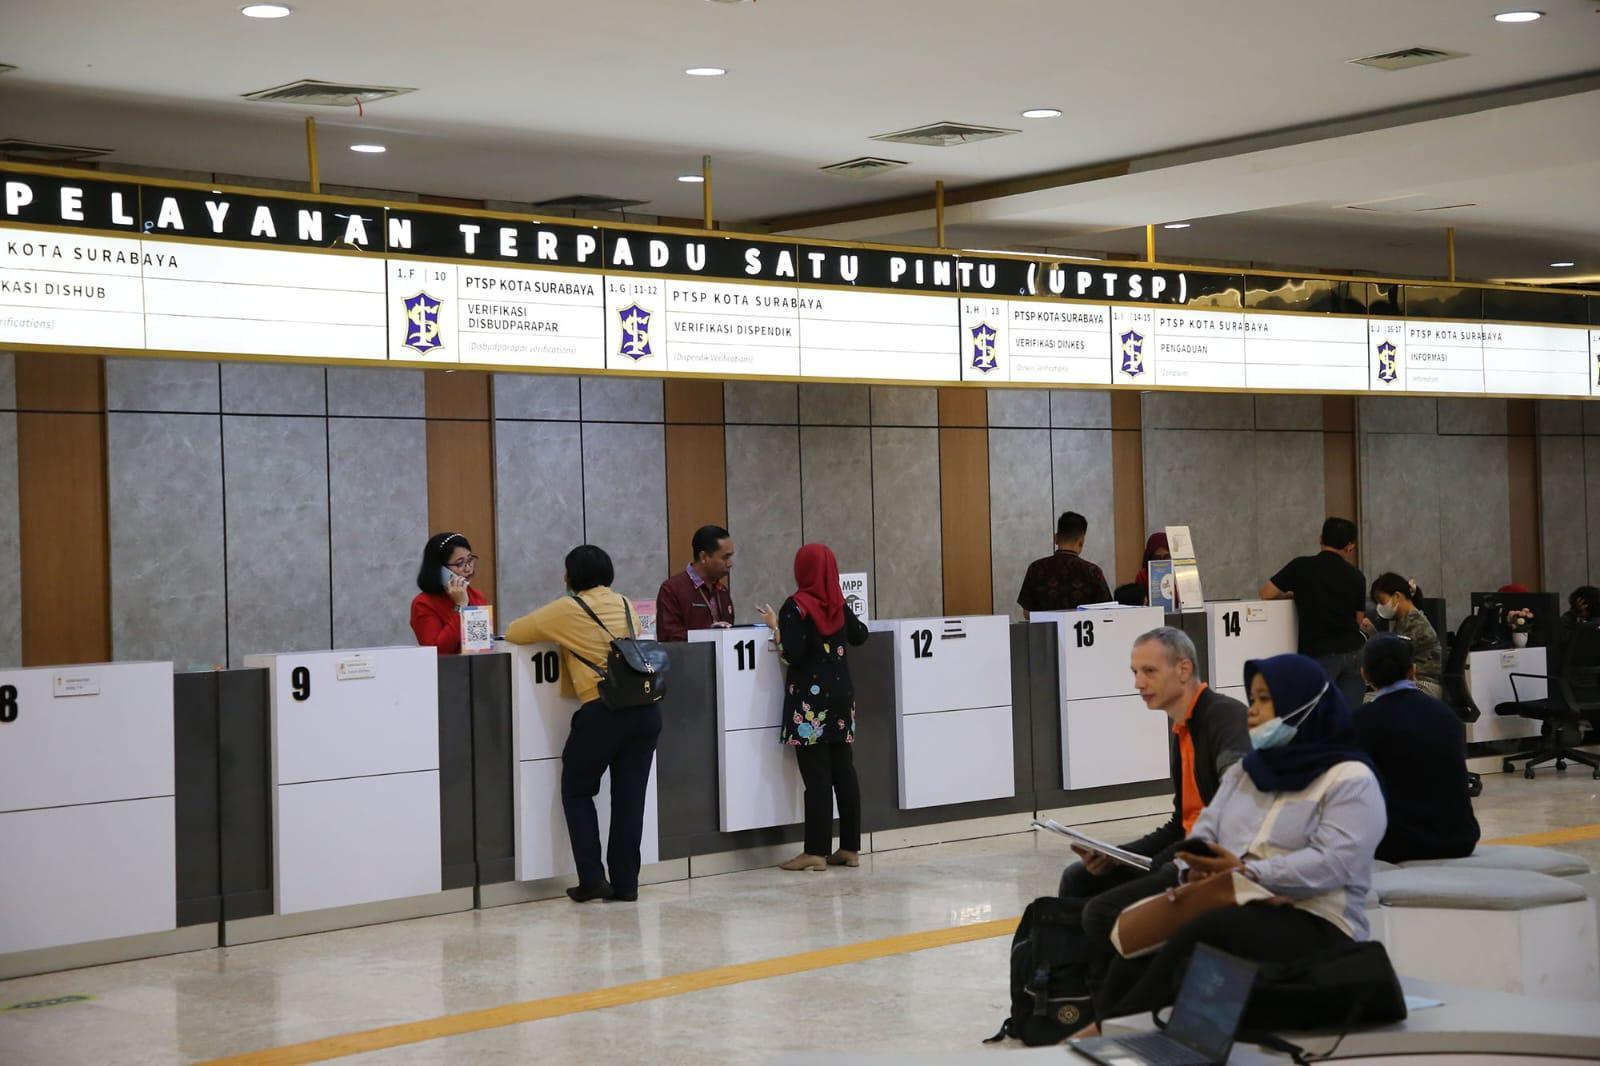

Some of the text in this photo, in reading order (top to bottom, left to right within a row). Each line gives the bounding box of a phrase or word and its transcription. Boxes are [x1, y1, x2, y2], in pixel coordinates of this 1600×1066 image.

[5, 181, 1187, 303] PELAYANAN TERPADU SATU PINTU (UPTSP)
[7, 241, 178, 269] KOTA SURABAYA
[435, 271, 446, 281] 10
[1, 280, 106, 299] KASI DISHUB
[465, 276, 595, 297] PTSP KOTA SURABAYA
[634, 285, 657, 295] 11-12
[672, 290, 823, 310] PTSP KOTA SURABAYA
[467, 303, 527, 317] VERIFIKASI
[1014, 310, 1104, 324] PTSP KOTA SURABAYA
[468, 317, 559, 333] DISBUDPARAPAR
[674, 321, 792, 337] VERIFIKASI DISPENDIK
[1160, 317, 1269, 333] PTSP KOTA SURABAYA
[1015, 338, 1085, 350] VERIFIKASI DINKES
[1410, 329, 1503, 342] PTSP KOTA SURABAYA
[1160, 343, 1208, 355] PENGADUAN
[1411, 352, 1448, 362] INFORMASI
[842, 580, 863, 591] MPP
[1222, 611, 1241, 637] 14
[1073, 620, 1094, 648] 13
[910, 629, 933, 659] 12
[734, 639, 756, 670] 11
[530, 650, 560, 684] 10
[291, 666, 311, 701] 9
[0, 684, 18, 723] 8
